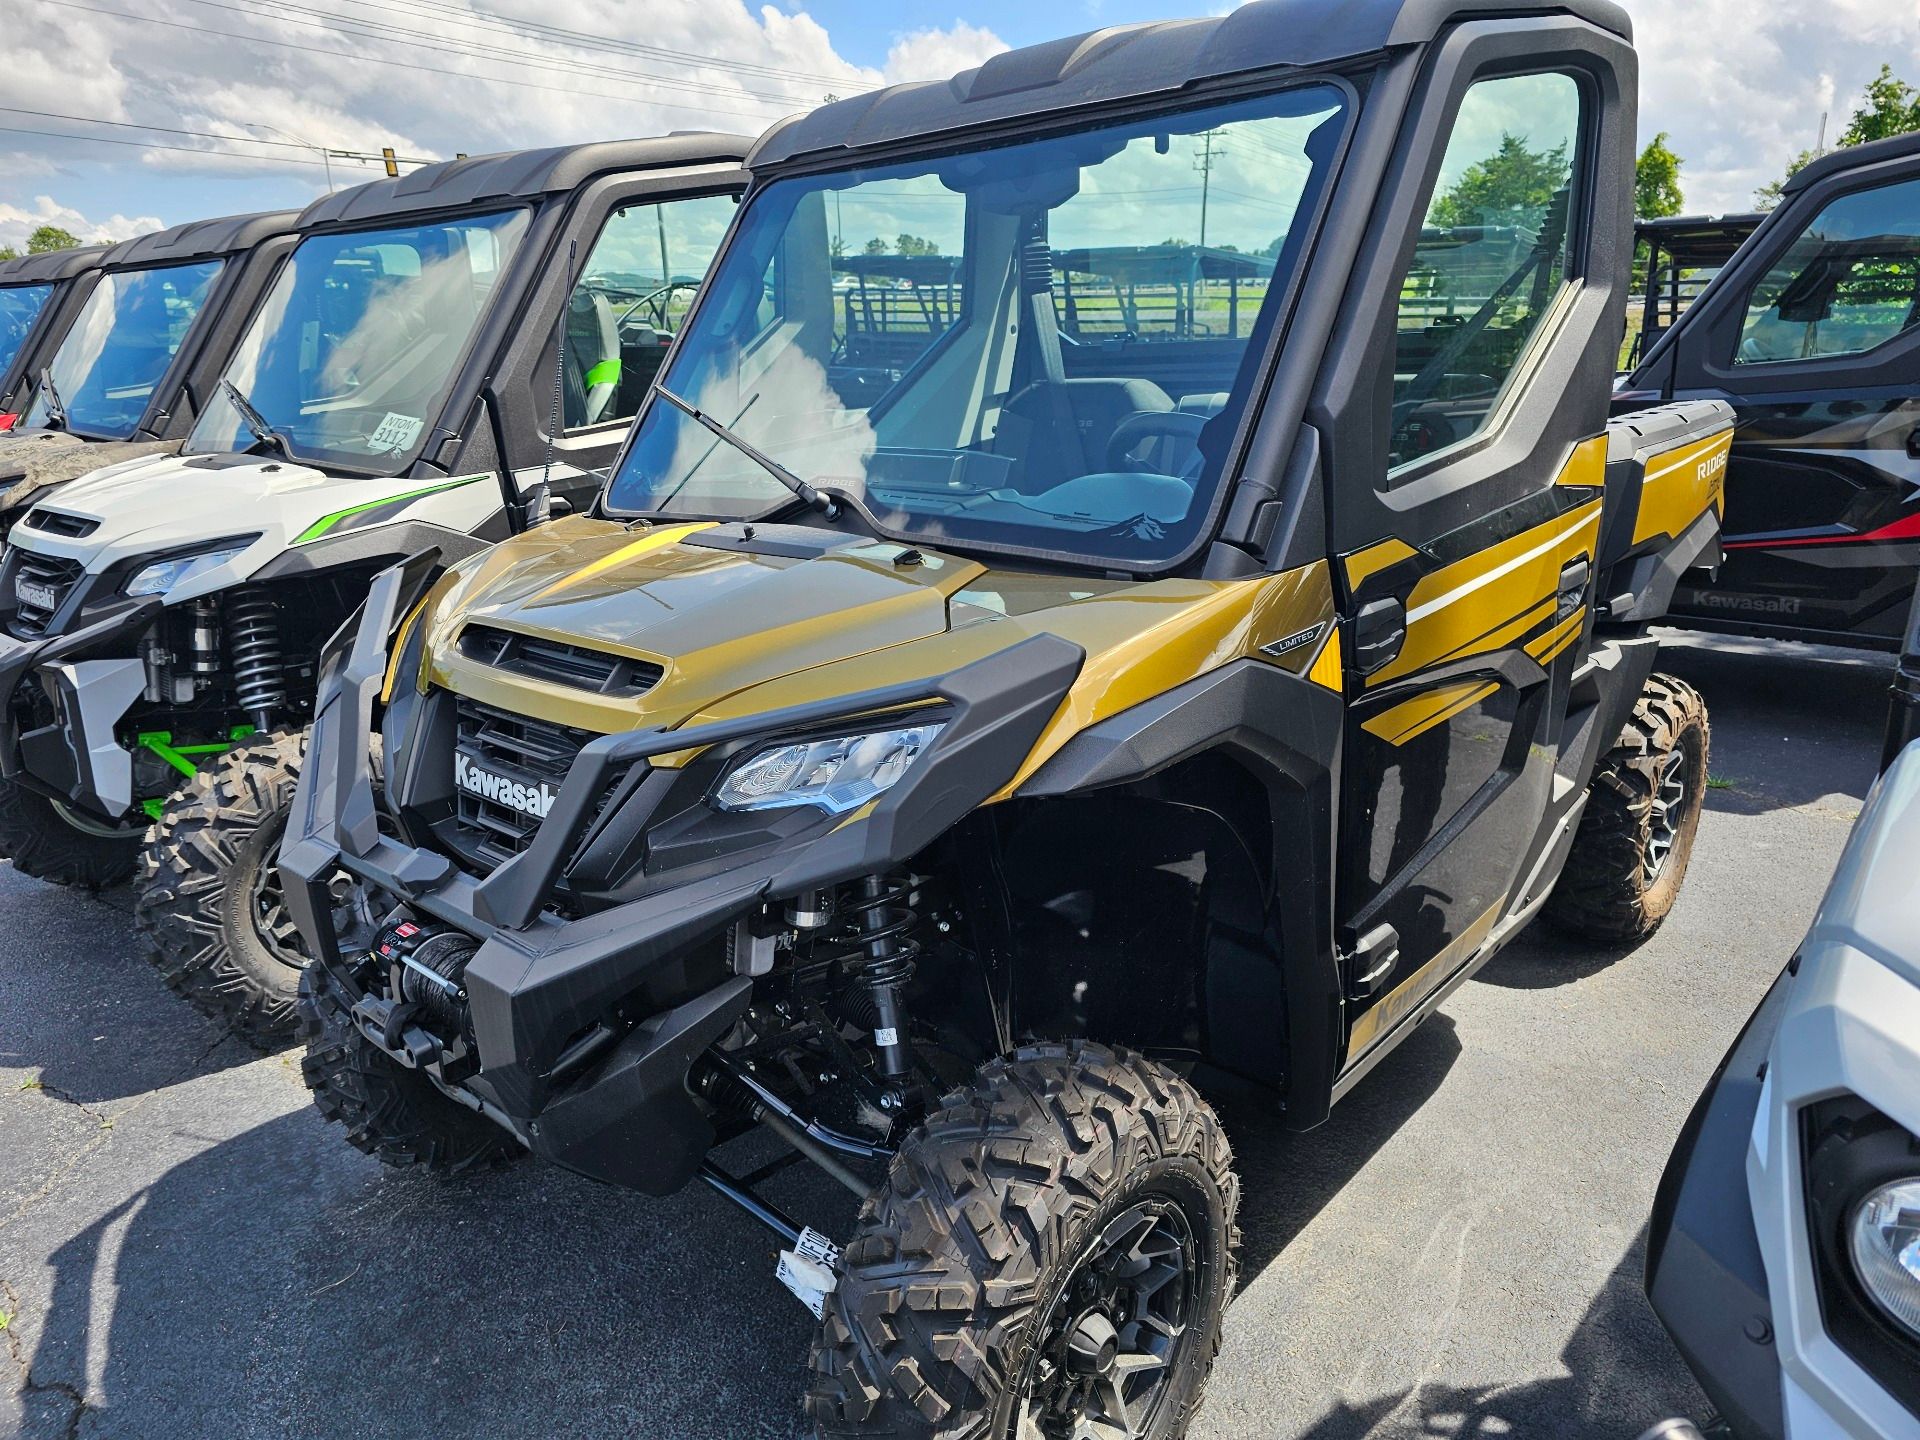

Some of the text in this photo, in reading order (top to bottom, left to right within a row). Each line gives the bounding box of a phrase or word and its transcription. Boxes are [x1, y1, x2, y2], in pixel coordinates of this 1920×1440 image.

[374, 427, 408, 447] 3112
[1697, 449, 1727, 481] RIDGE
[818, 477, 857, 488] RIDGE
[15, 577, 55, 610] Kawasaki
[1692, 591, 1802, 615] Kawasaki
[1279, 630, 1315, 651] LIMITED
[454, 751, 562, 819] Kawasak
